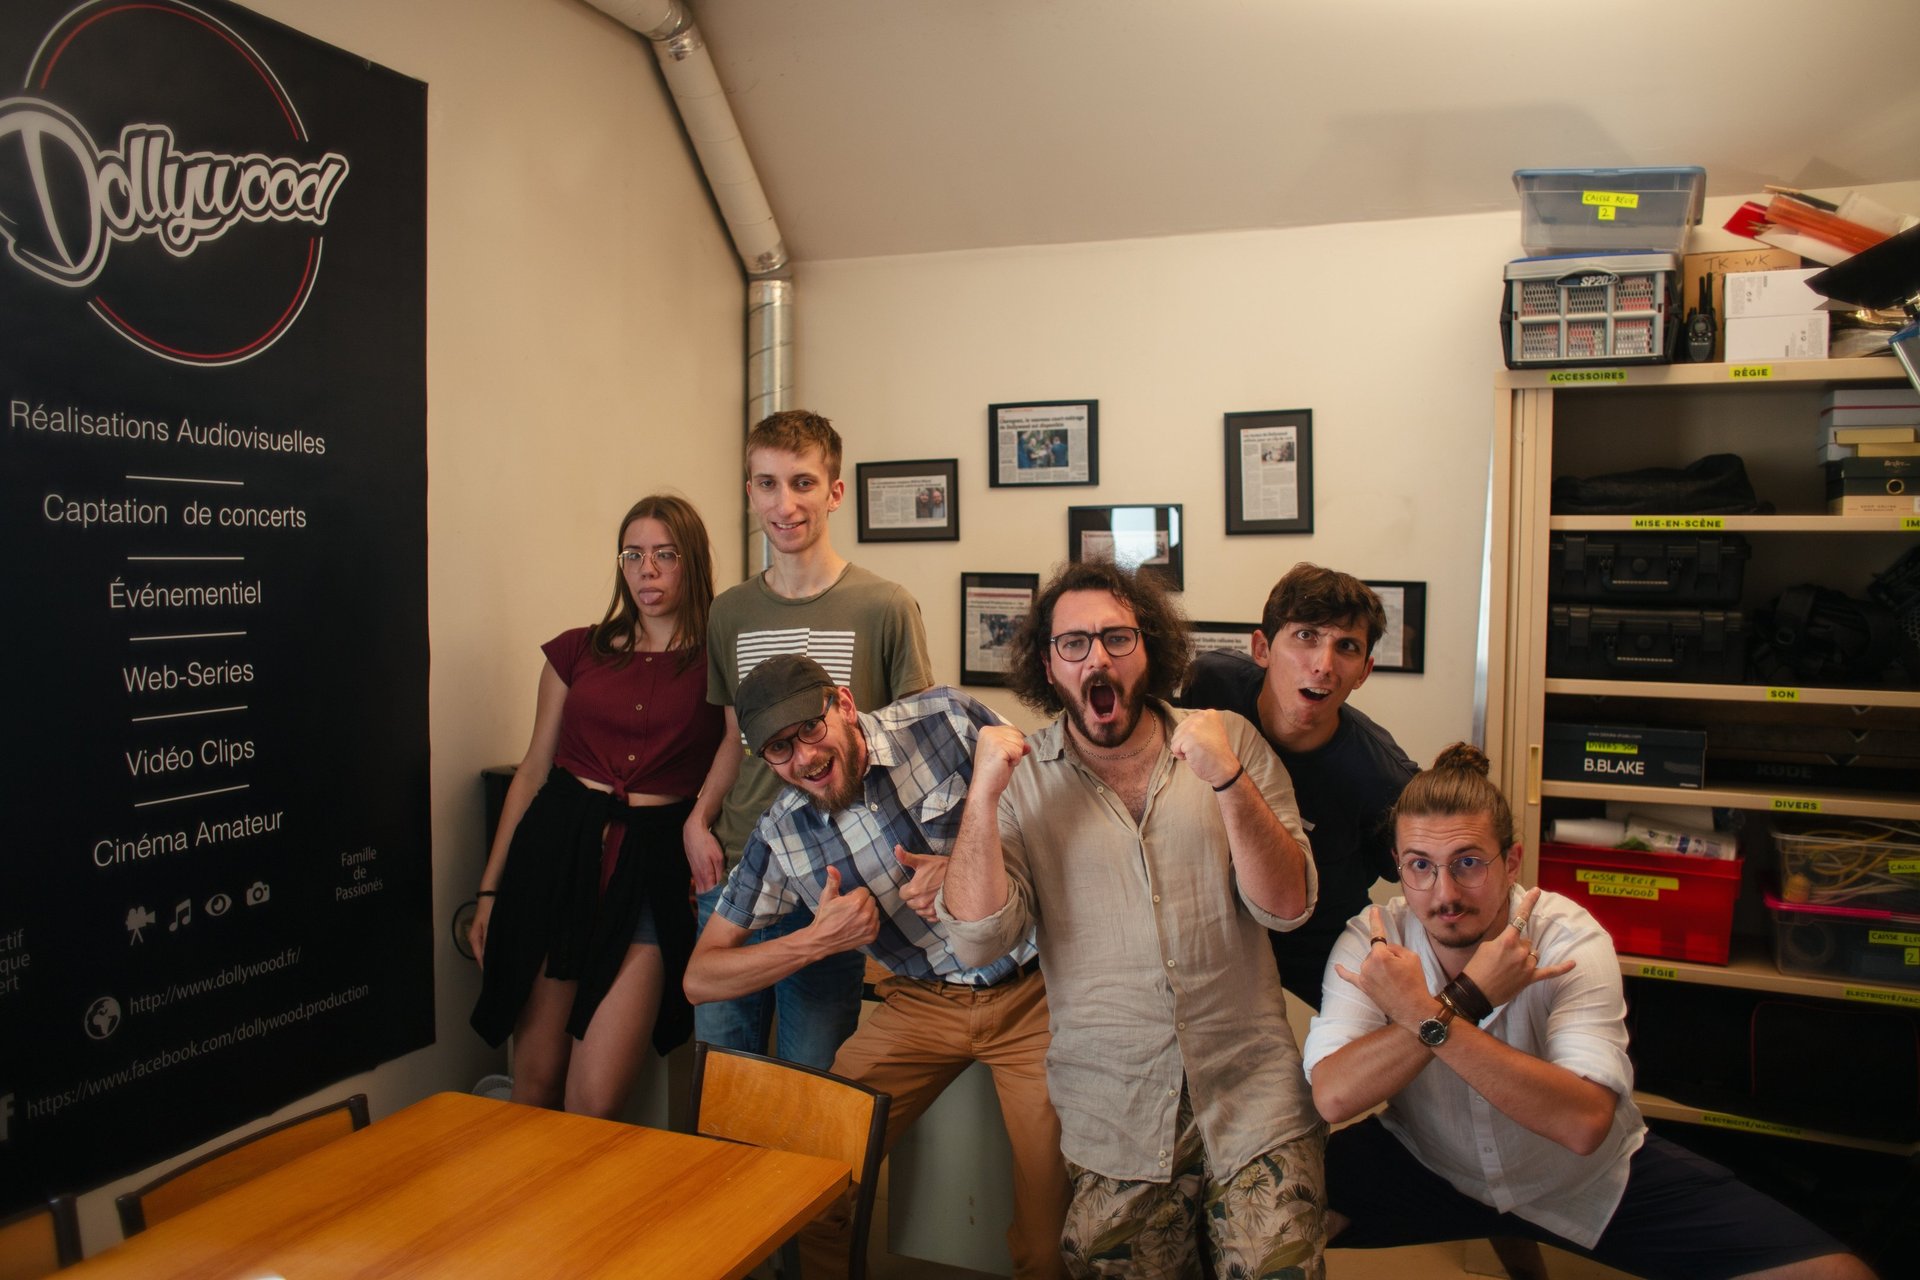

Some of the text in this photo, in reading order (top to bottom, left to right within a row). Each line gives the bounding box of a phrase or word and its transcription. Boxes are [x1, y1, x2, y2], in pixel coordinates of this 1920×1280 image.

[0, 97, 349, 288] Dollywood
[1601, 207, 1610, 217] 2
[1550, 371, 1625, 382] ACCESSOIRES
[1734, 368, 1768, 378] RÉGIE
[10, 400, 326, 455] Réalisations Audiovisuelles
[43, 493, 307, 529] Captation de concerts
[1635, 518, 1721, 528] MISE-EN-SCÈNE
[109, 576, 262, 609] Événementiel
[123, 660, 254, 693] Web-Series
[1770, 690, 1795, 699] SON
[126, 738, 255, 777] Vidéo Clips
[1584, 758, 1645, 775] B.BLAKE
[1775, 800, 1817, 810] DIVERS
[93, 809, 284, 868] Cinéma Amateur
[341, 847, 377, 867] Famille
[353, 865, 367, 880] de
[1583, 872, 1617, 881] CAISSE
[335, 877, 383, 902] Passionés
[1592, 885, 1655, 898] DOLLYWOOD
[0, 952, 32, 977] que
[1906, 952, 1918, 964] 2
[130, 947, 301, 1014] http://www.dollywood.fr/
[1643, 966, 1675, 978] RÉGIE
[26, 983, 370, 1120] https://www.facebook.com/dollywood.production
